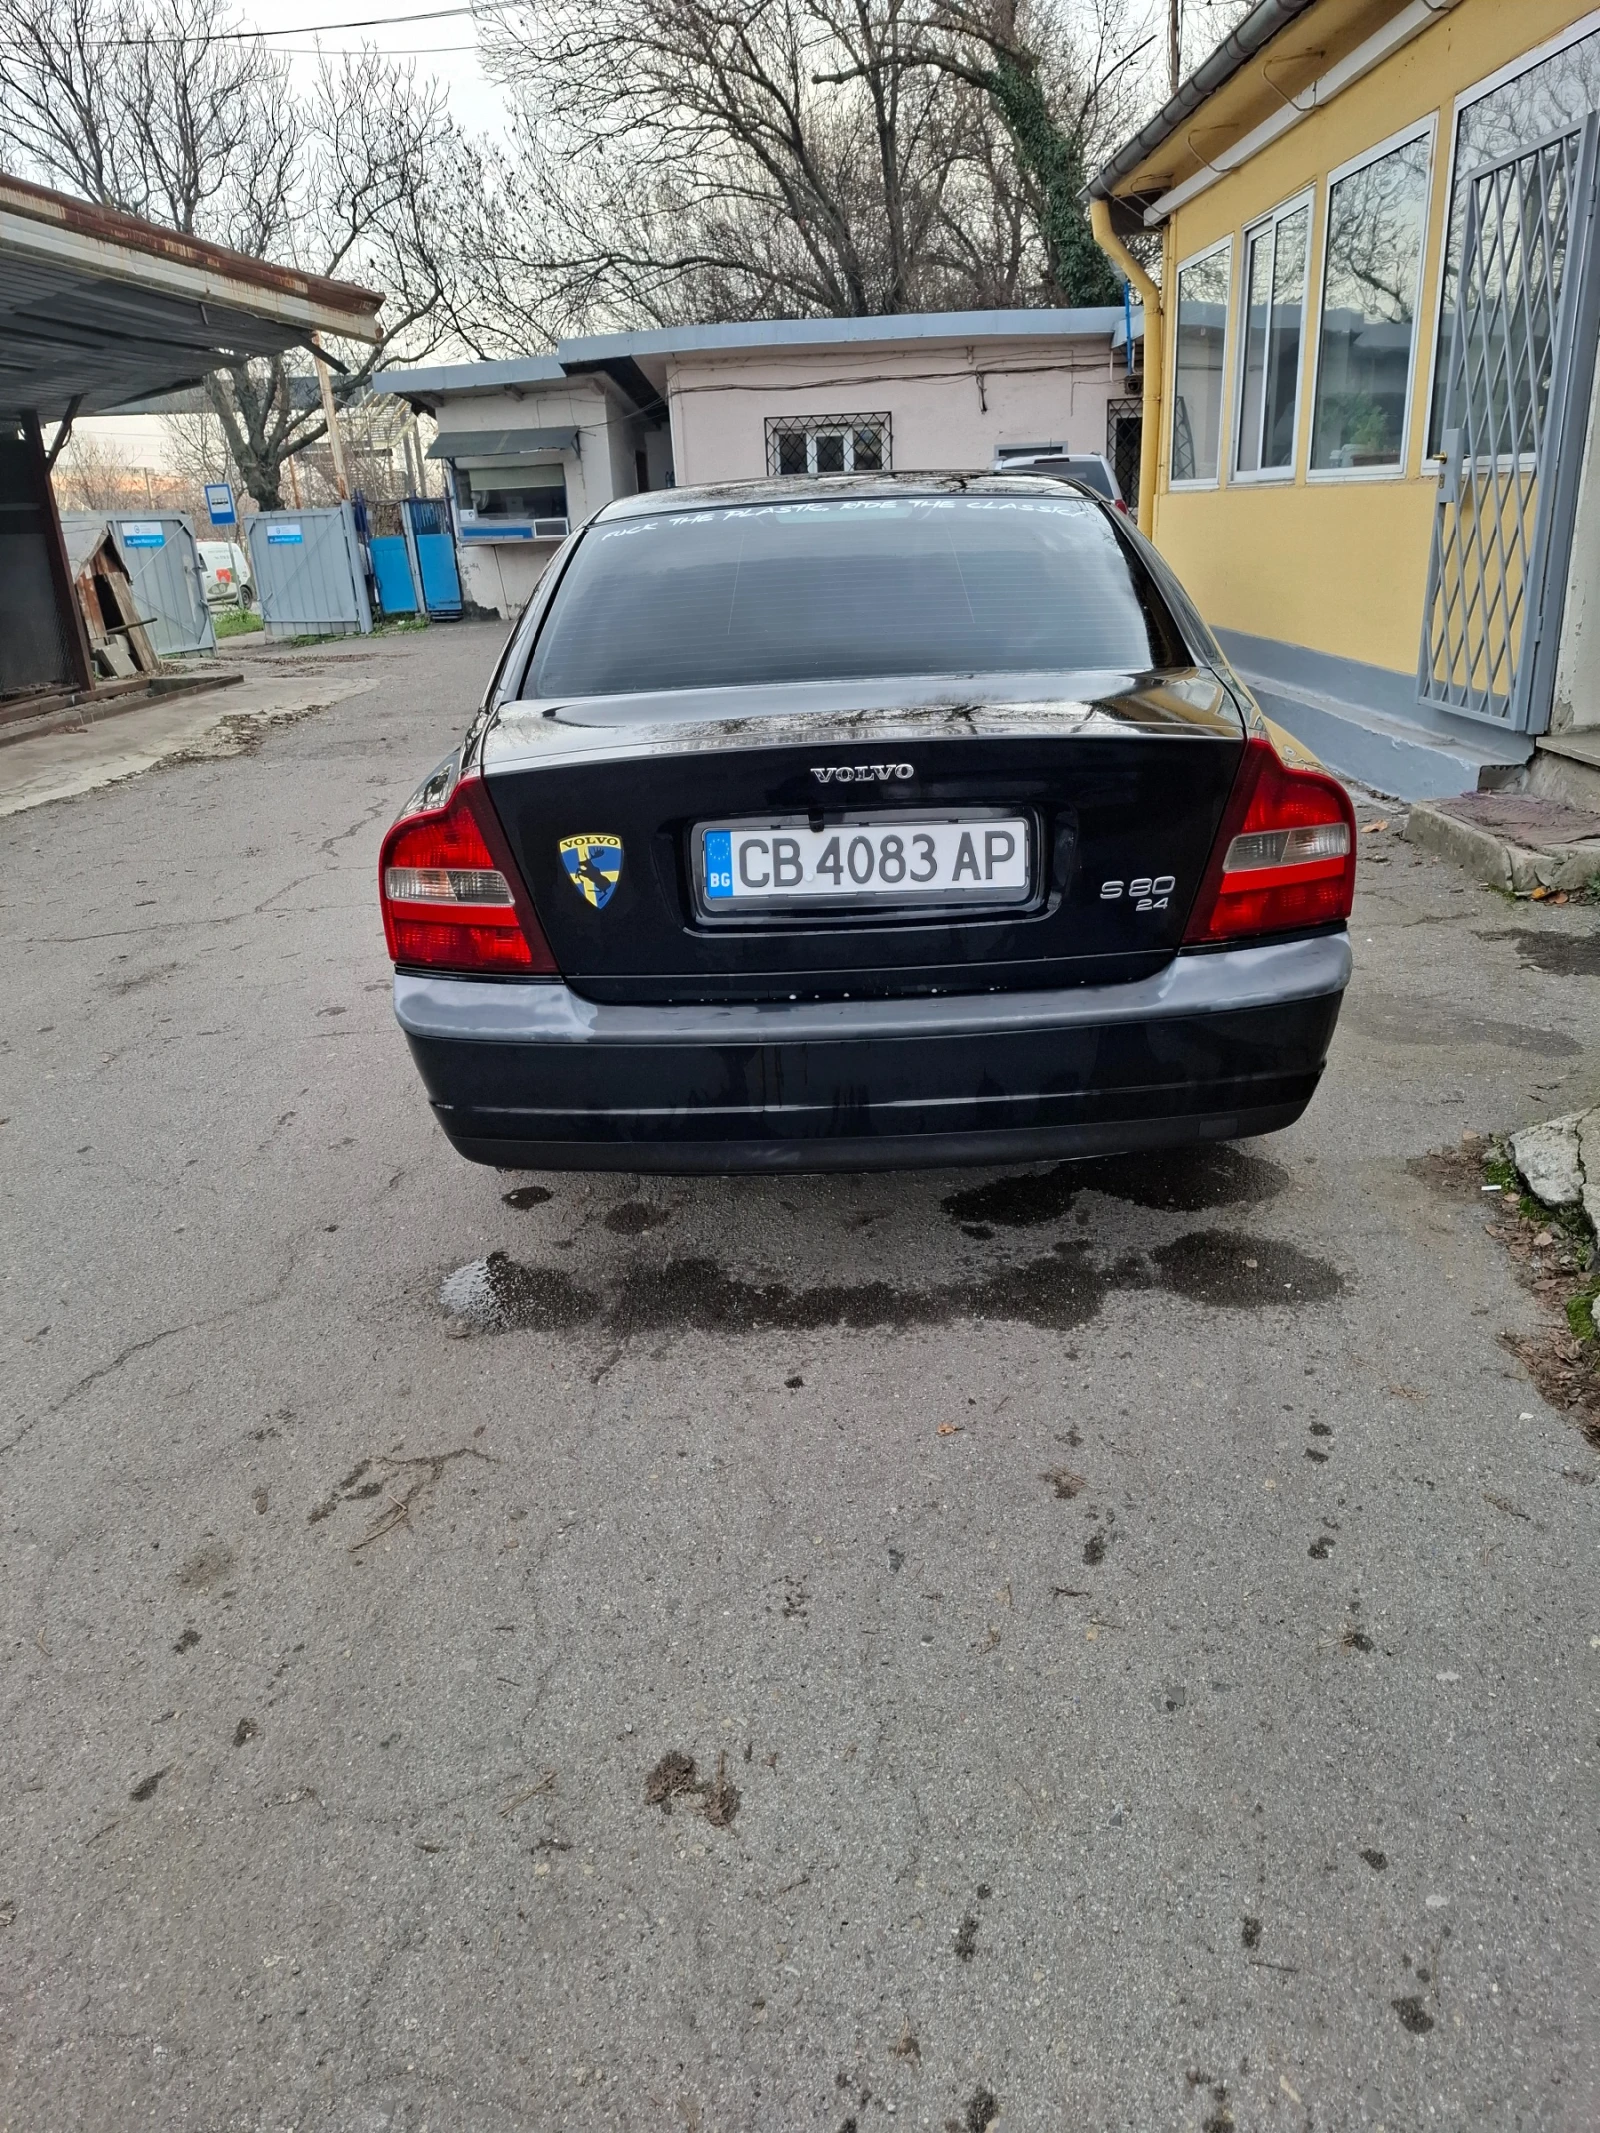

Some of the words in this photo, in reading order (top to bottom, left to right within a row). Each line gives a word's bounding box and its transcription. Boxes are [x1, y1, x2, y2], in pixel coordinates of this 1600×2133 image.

[602, 522, 658, 541] FUCK
[669, 513, 715, 526] THE
[840, 501, 898, 511] RIDE
[908, 500, 956, 509] THE
[810, 763, 914, 783] VOLVO
[562, 836, 618, 848] VOLVO
[738, 837, 804, 888] CB
[815, 832, 938, 886] 4083
[951, 830, 1016, 882] AP
[710, 872, 731, 888] BG
